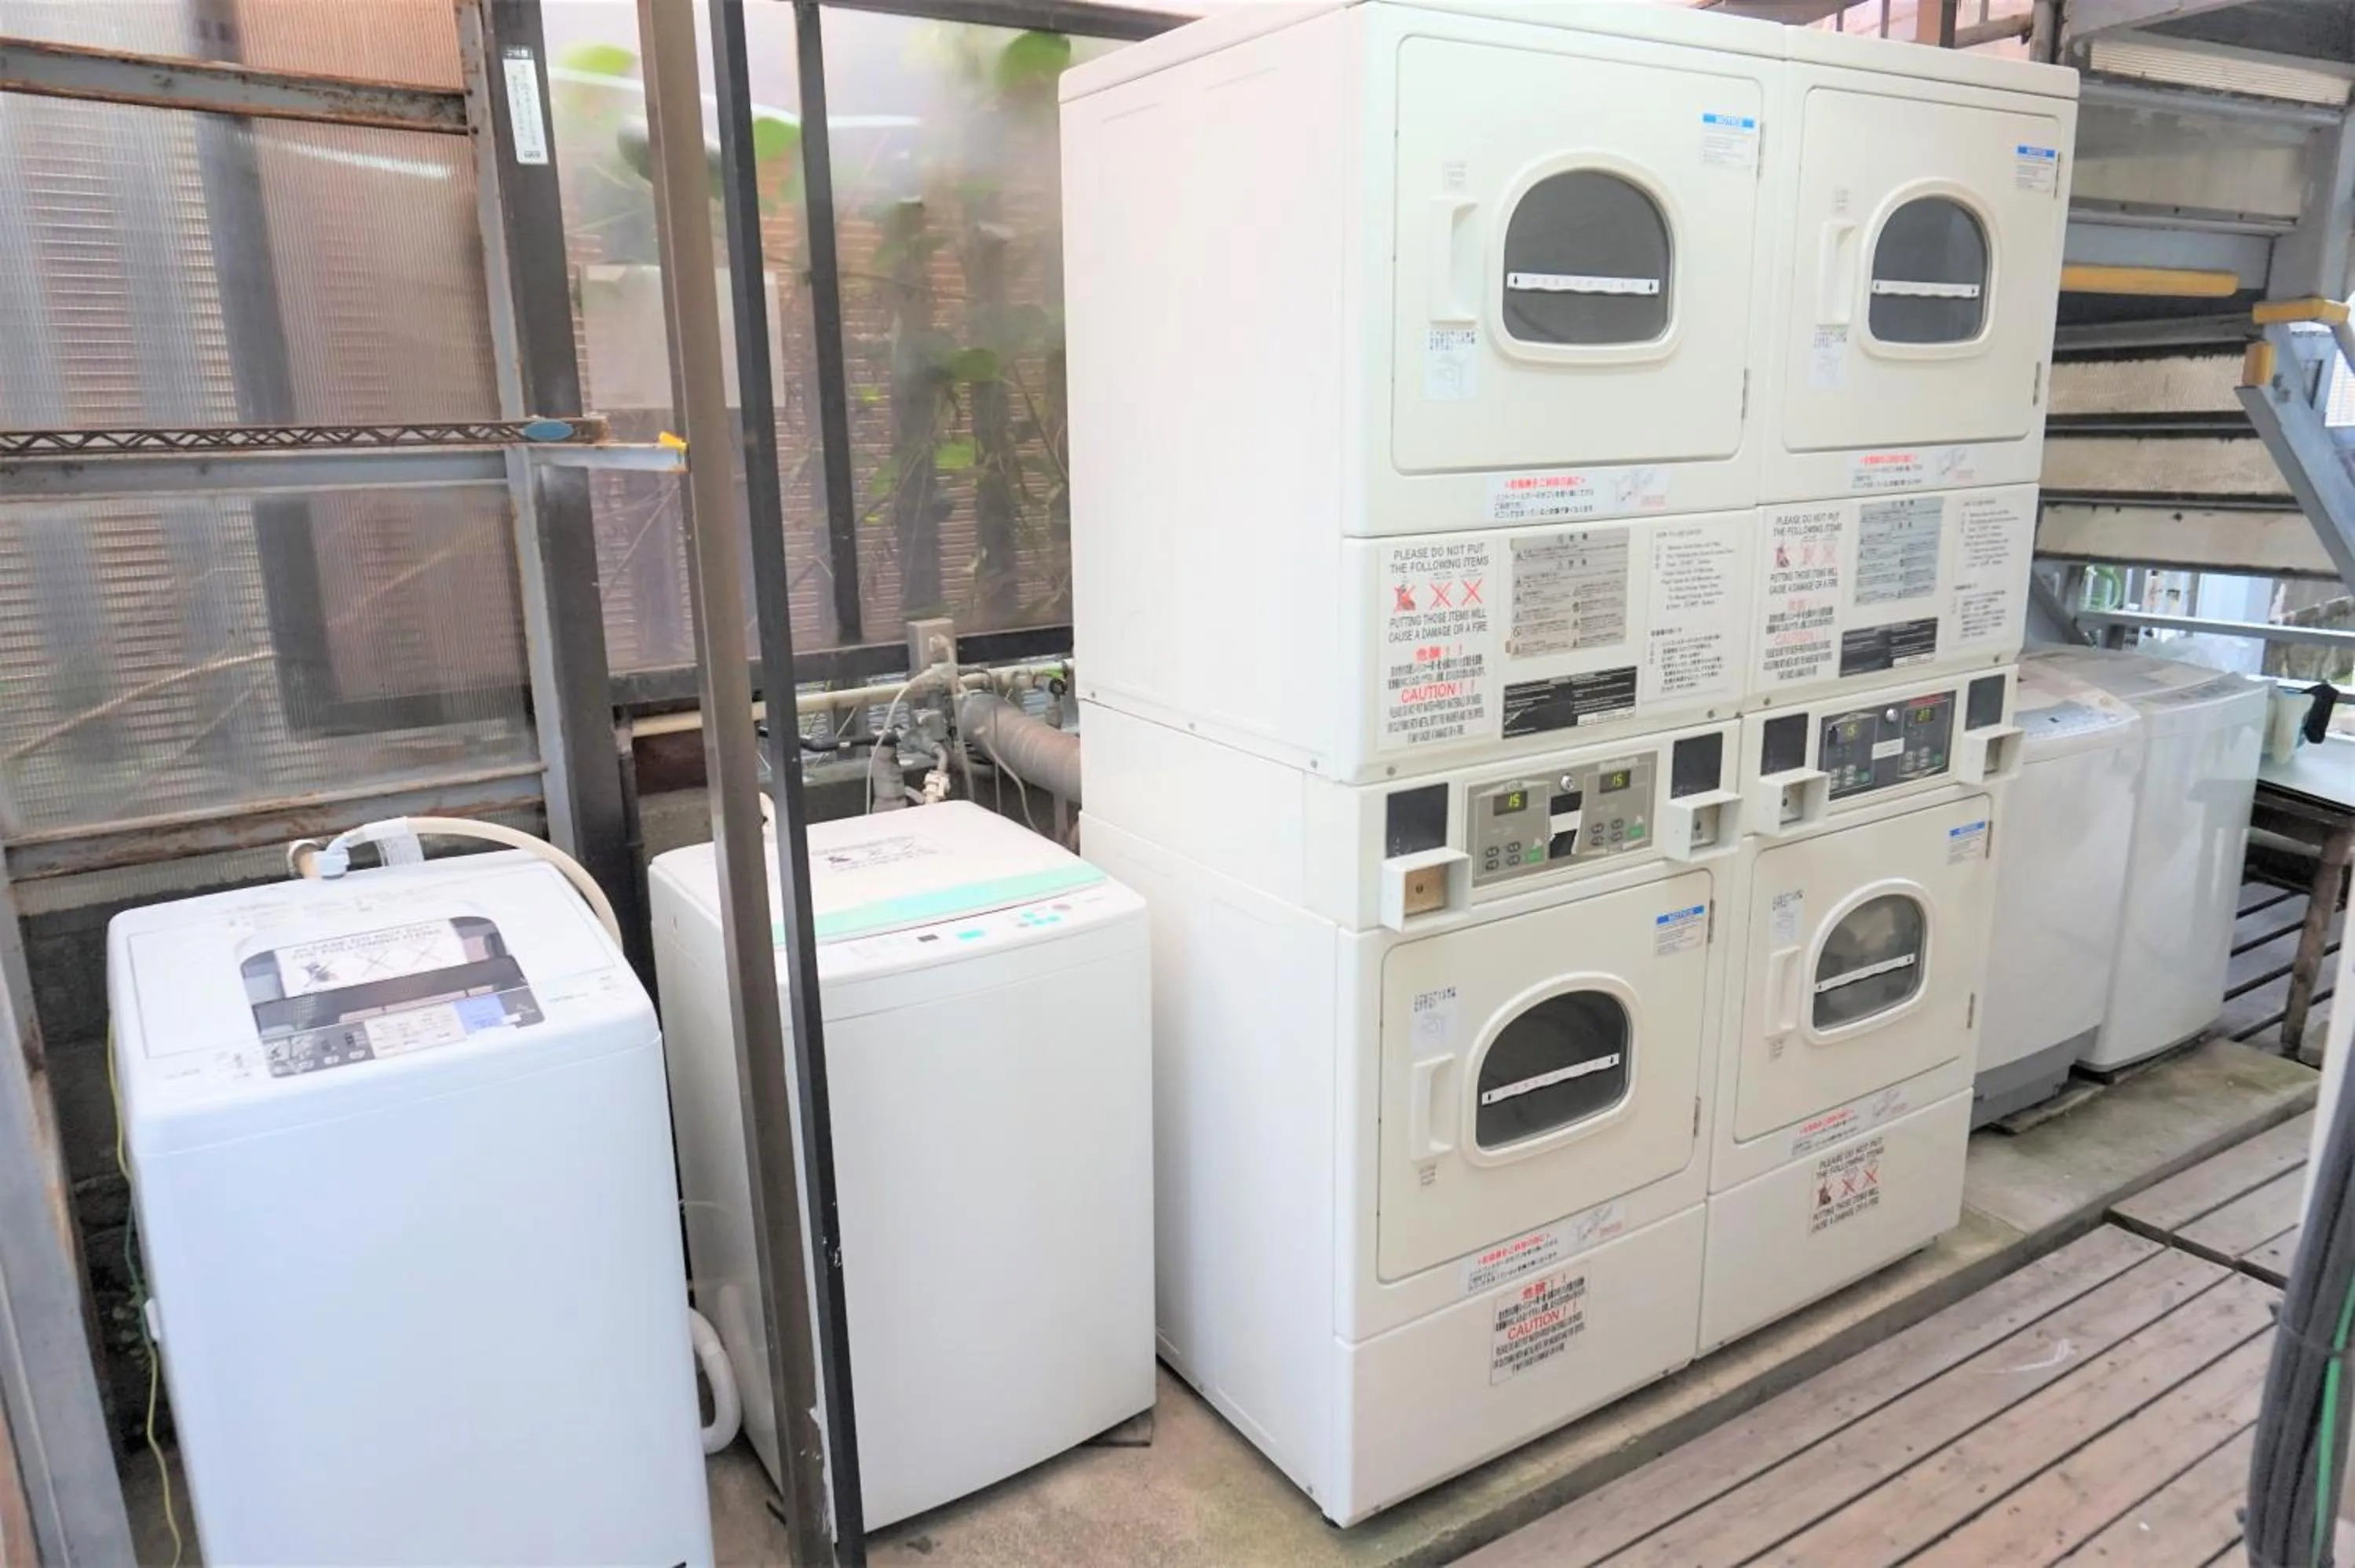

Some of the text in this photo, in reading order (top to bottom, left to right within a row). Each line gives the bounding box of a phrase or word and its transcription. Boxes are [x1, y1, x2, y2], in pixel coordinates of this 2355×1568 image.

[1394, 542, 1485, 560] PLEASE DO NOT PUT
[1390, 556, 1489, 574] THE FOLLOWING ITEMS
[1389, 614, 1422, 629] PUTTING
[1423, 611, 1446, 623] THOSE
[1448, 610, 1470, 622] ITEMS
[1388, 629, 1413, 643] CAUSE
[1422, 625, 1451, 639] DAMAGE
